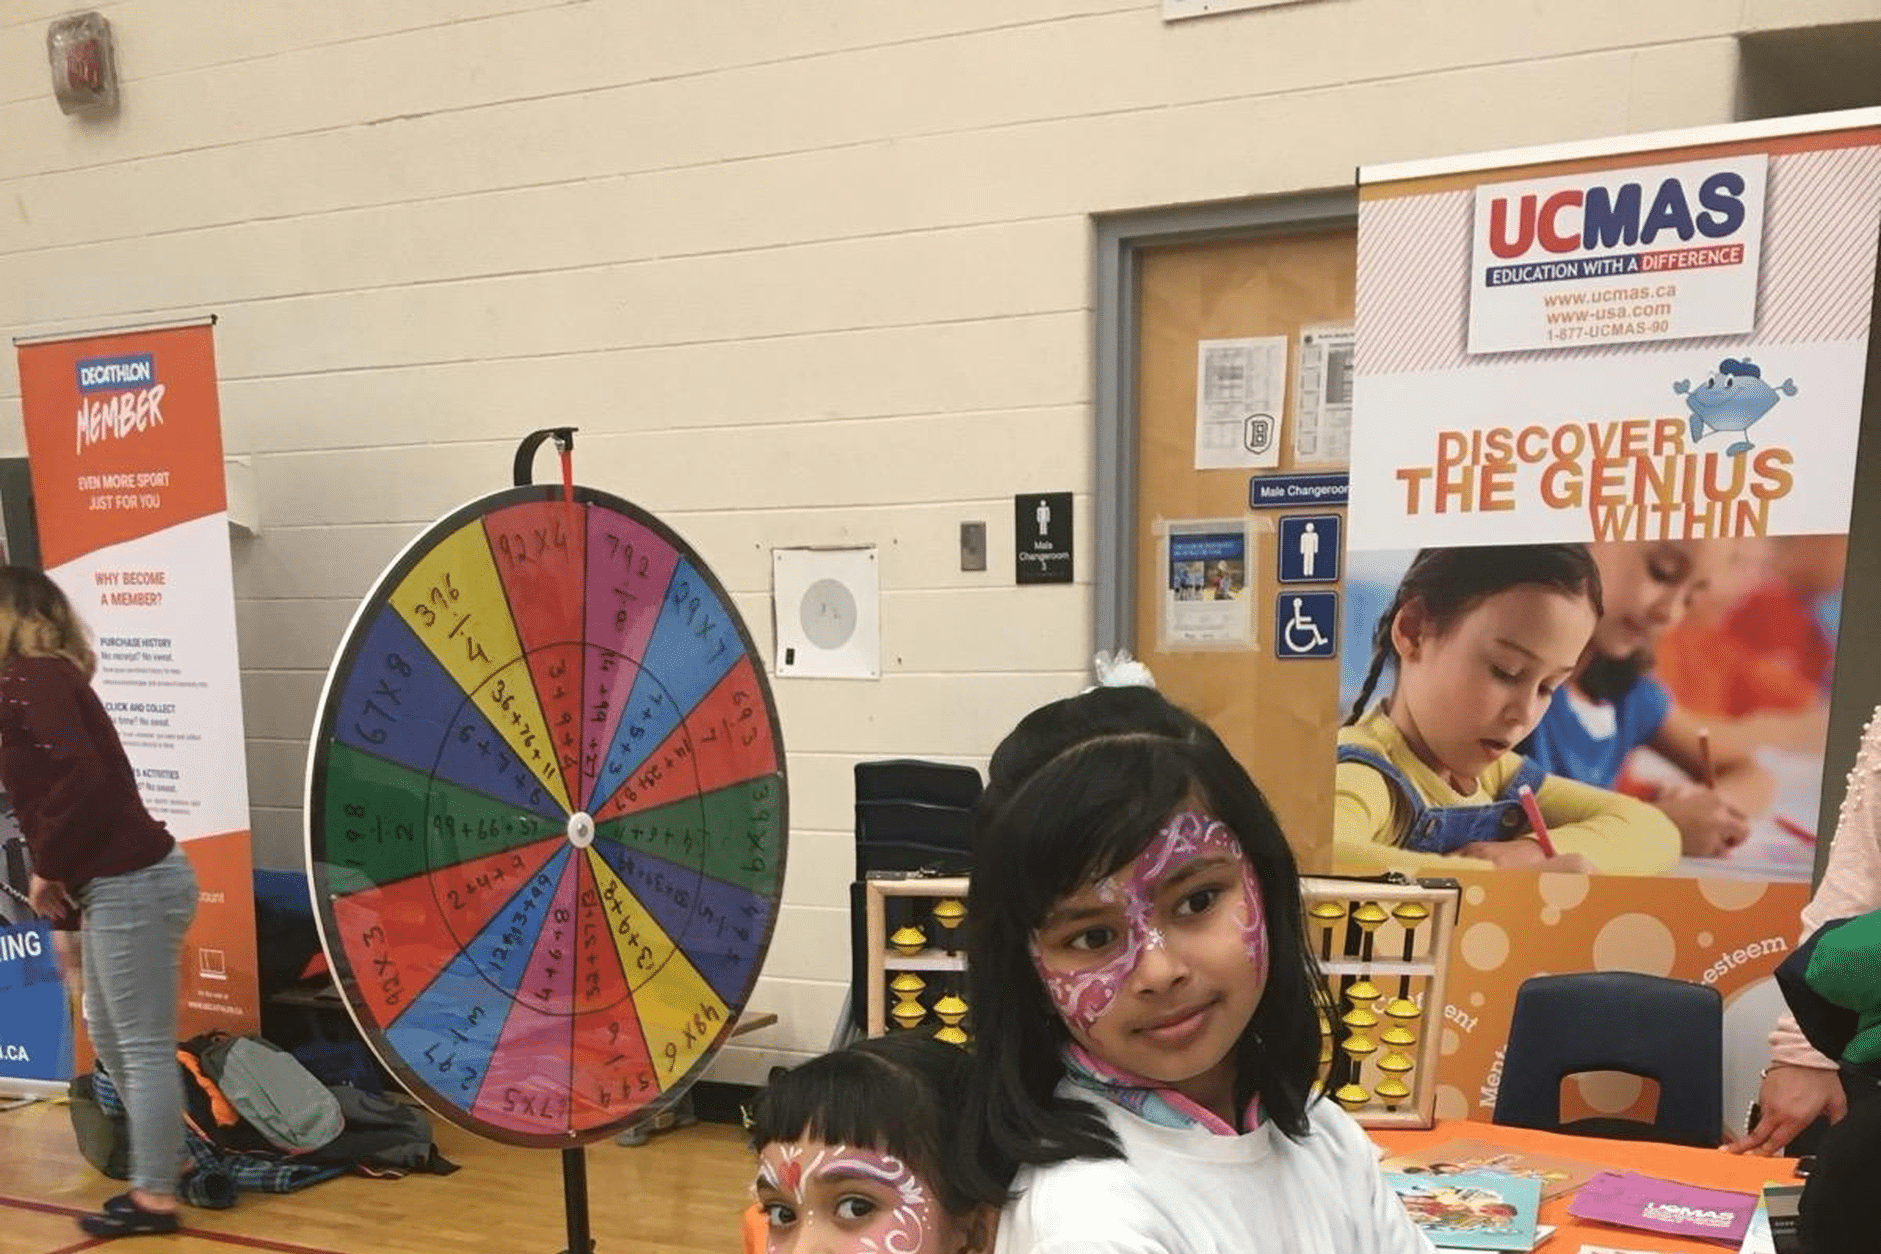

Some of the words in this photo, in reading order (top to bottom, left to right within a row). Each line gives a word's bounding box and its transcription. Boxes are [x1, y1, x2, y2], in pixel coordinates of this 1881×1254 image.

[1490, 172, 1745, 260] UCMAS
[1492, 264, 1578, 284] EDUCATION
[1582, 258, 1623, 280] WITH
[1627, 259, 1638, 272] A
[1642, 247, 1740, 271] DIFFERENCE
[1544, 283, 1676, 307] www.ucmas.ca
[1546, 303, 1671, 324] www-usa.com
[1548, 320, 1669, 342] 1-877-UCMAS-90
[80, 361, 151, 387] DECATHLON
[76, 384, 165, 456] MEMBER
[1438, 417, 1687, 468] DISCOVER
[77, 475, 101, 491] EVEN
[102, 474, 136, 489] MORE
[136, 472, 170, 488] SPORT
[1260, 486, 1286, 497] Male
[1396, 463, 1517, 515] THE
[1540, 447, 1794, 510] GENIUS
[89, 496, 113, 510] JUST
[116, 495, 137, 509] FOR
[138, 494, 161, 509] YOU
[1589, 500, 1773, 542] WITHIN
[607, 533, 649, 578] 792
[95, 572, 119, 586] WHY
[122, 571, 166, 586] BECOME
[101, 593, 109, 606] A
[110, 592, 163, 607] MEMBER?
[414, 572, 461, 628] 396
[129, 703, 144, 713] AND
[145, 703, 177, 714] COLLECT
[0, 930, 42, 962] ING
